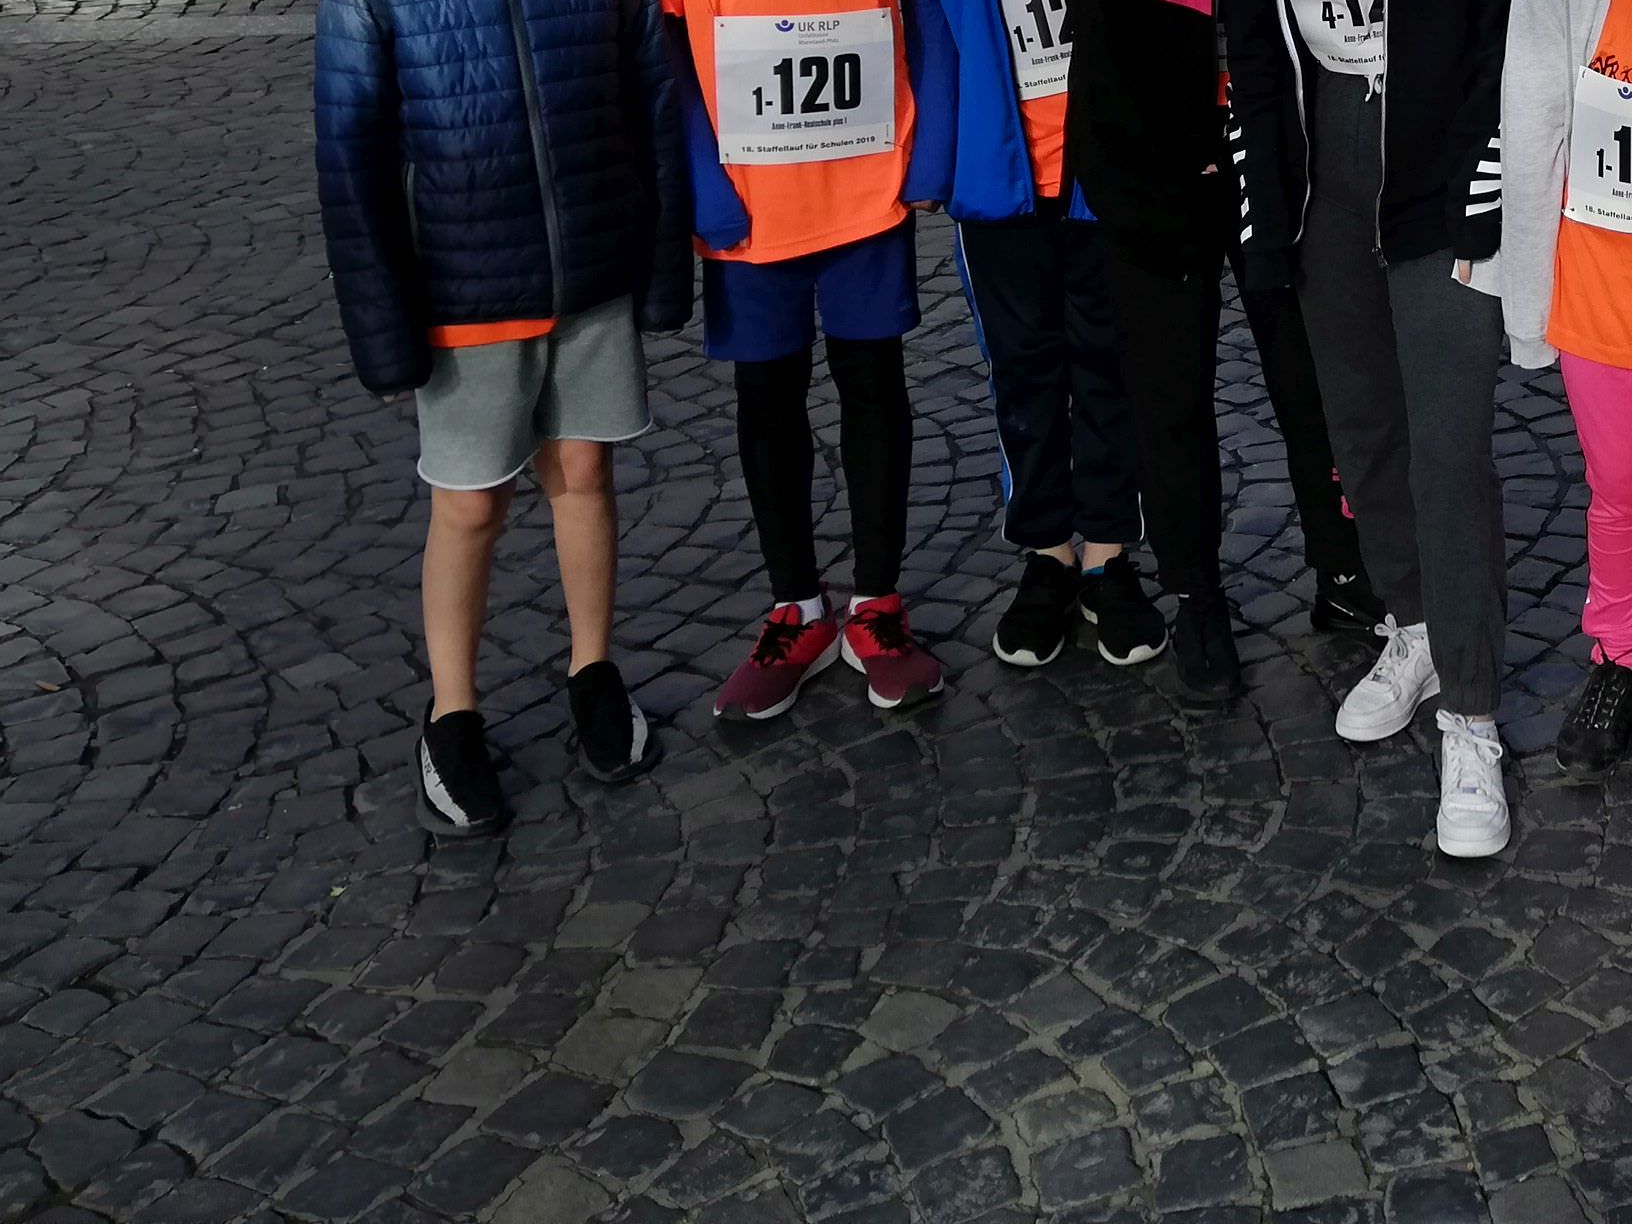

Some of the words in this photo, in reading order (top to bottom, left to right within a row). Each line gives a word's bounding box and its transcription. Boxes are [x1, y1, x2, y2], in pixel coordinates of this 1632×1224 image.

[798, 22, 815, 32] UK
[818, 20, 840, 31] RLP
[752, 53, 862, 116] 1-120
[1024, 74, 1066, 88] Staffellauf
[756, 144, 804, 153] Staffellauf
[820, 139, 854, 149] Schulen
[856, 135, 876, 145] 2019
